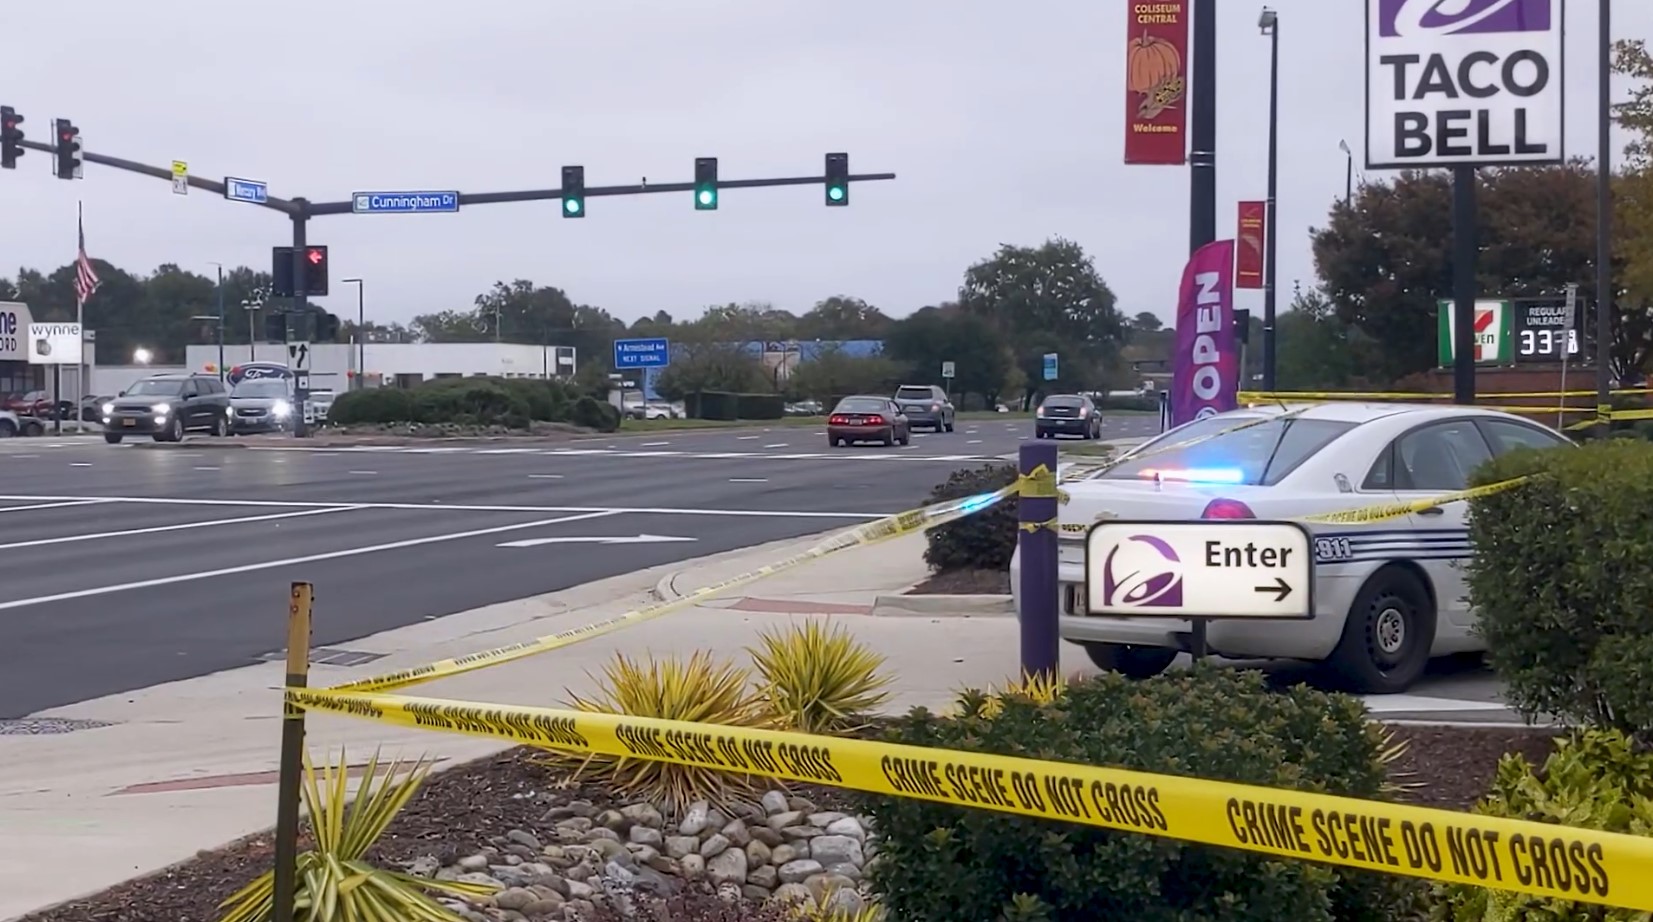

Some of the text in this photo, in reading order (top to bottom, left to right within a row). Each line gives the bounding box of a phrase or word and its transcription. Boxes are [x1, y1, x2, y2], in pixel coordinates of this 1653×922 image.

[1134, 4, 1180, 13] COLISEUM
[1138, 14, 1177, 23] CENTRAL
[1380, 49, 1549, 100] TACO
[1133, 123, 1178, 133] Welcome
[1394, 108, 1547, 157] BELL
[371, 195, 454, 211] Cunningham Dr
[32, 325, 79, 338] wynne
[1192, 272, 1221, 400] OPEN
[1526, 316, 1566, 325] UNLEADE
[1205, 541, 1292, 567] Enter
[403, 702, 589, 747] CRIME SCENE DO NOT CROSS
[615, 723, 842, 783] CRIME SCENE DO NOT CROSS
[881, 754, 1167, 831] CRIME SCENE DO NOT CROSS
[1226, 797, 1609, 897] CRIME SCENE DO NOT CROSS
